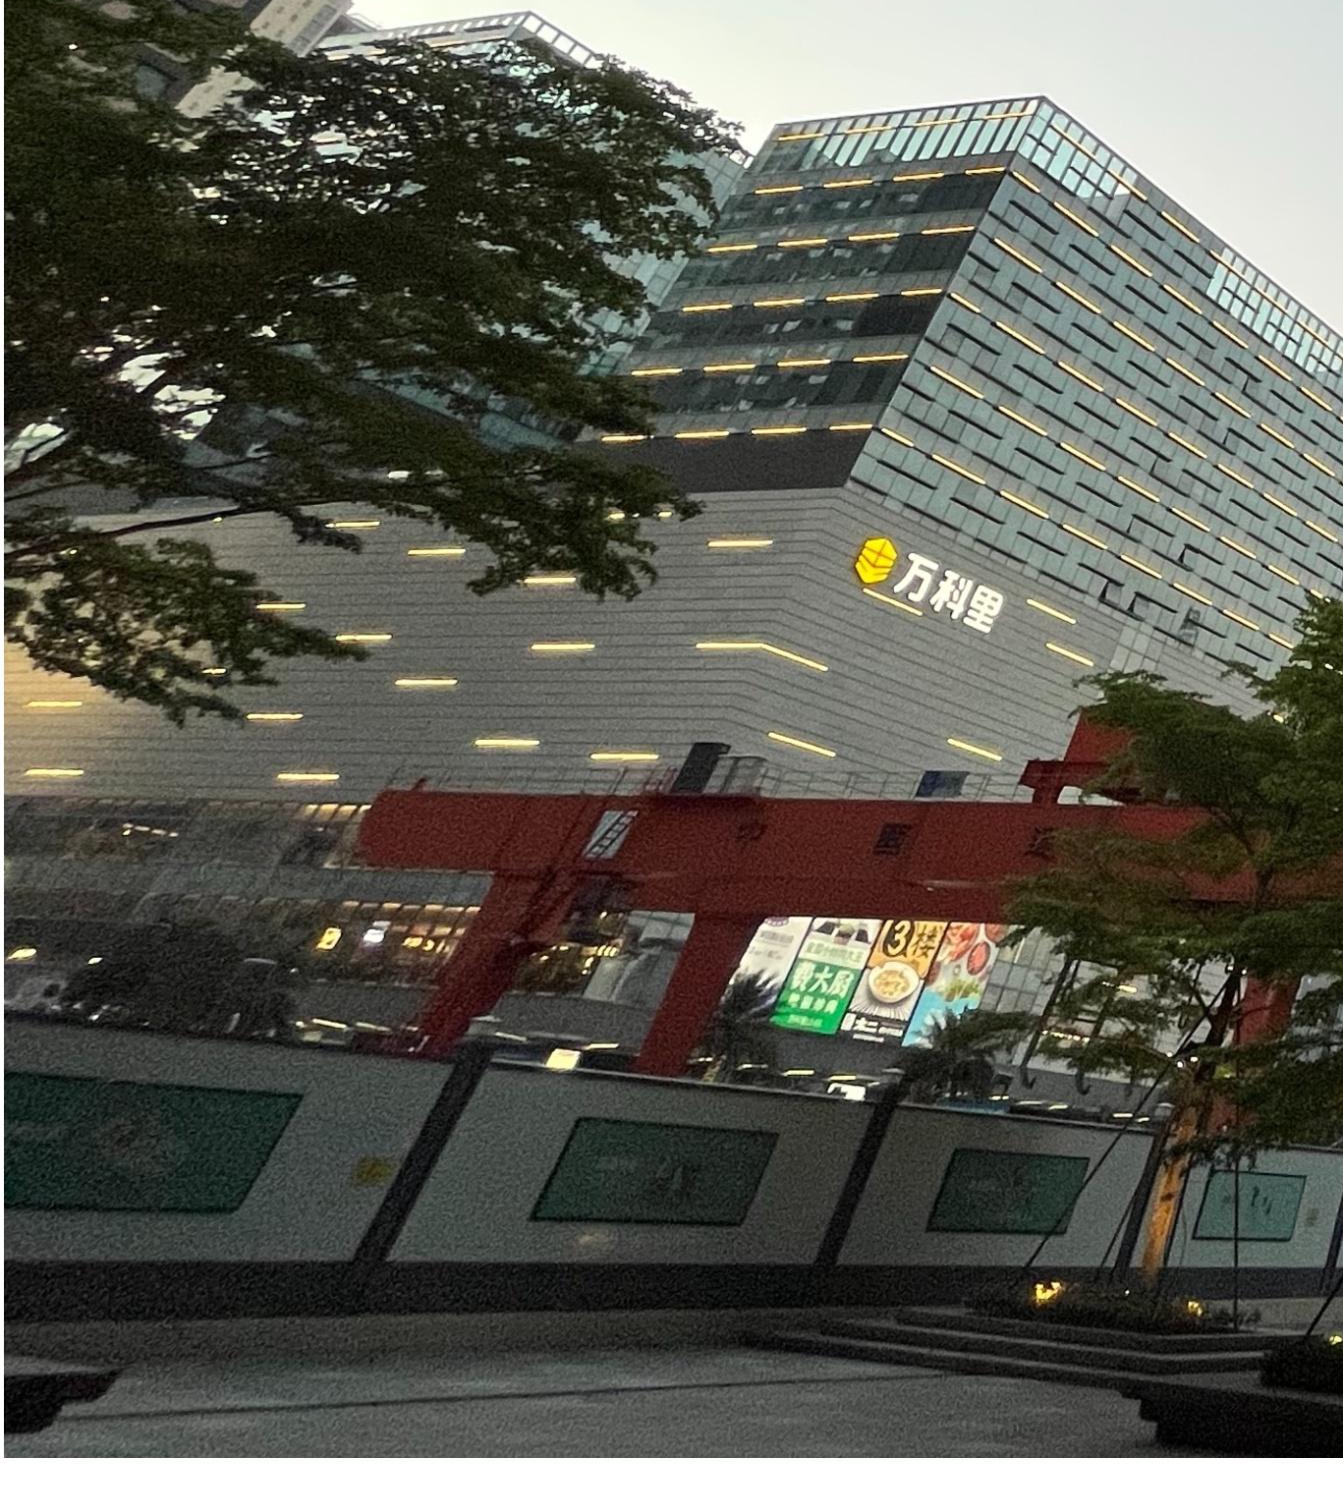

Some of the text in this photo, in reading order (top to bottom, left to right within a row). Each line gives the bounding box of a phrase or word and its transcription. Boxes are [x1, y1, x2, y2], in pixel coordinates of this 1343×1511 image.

[893, 552, 1004, 634] 万科里
[886, 919, 943, 958] 3楼
